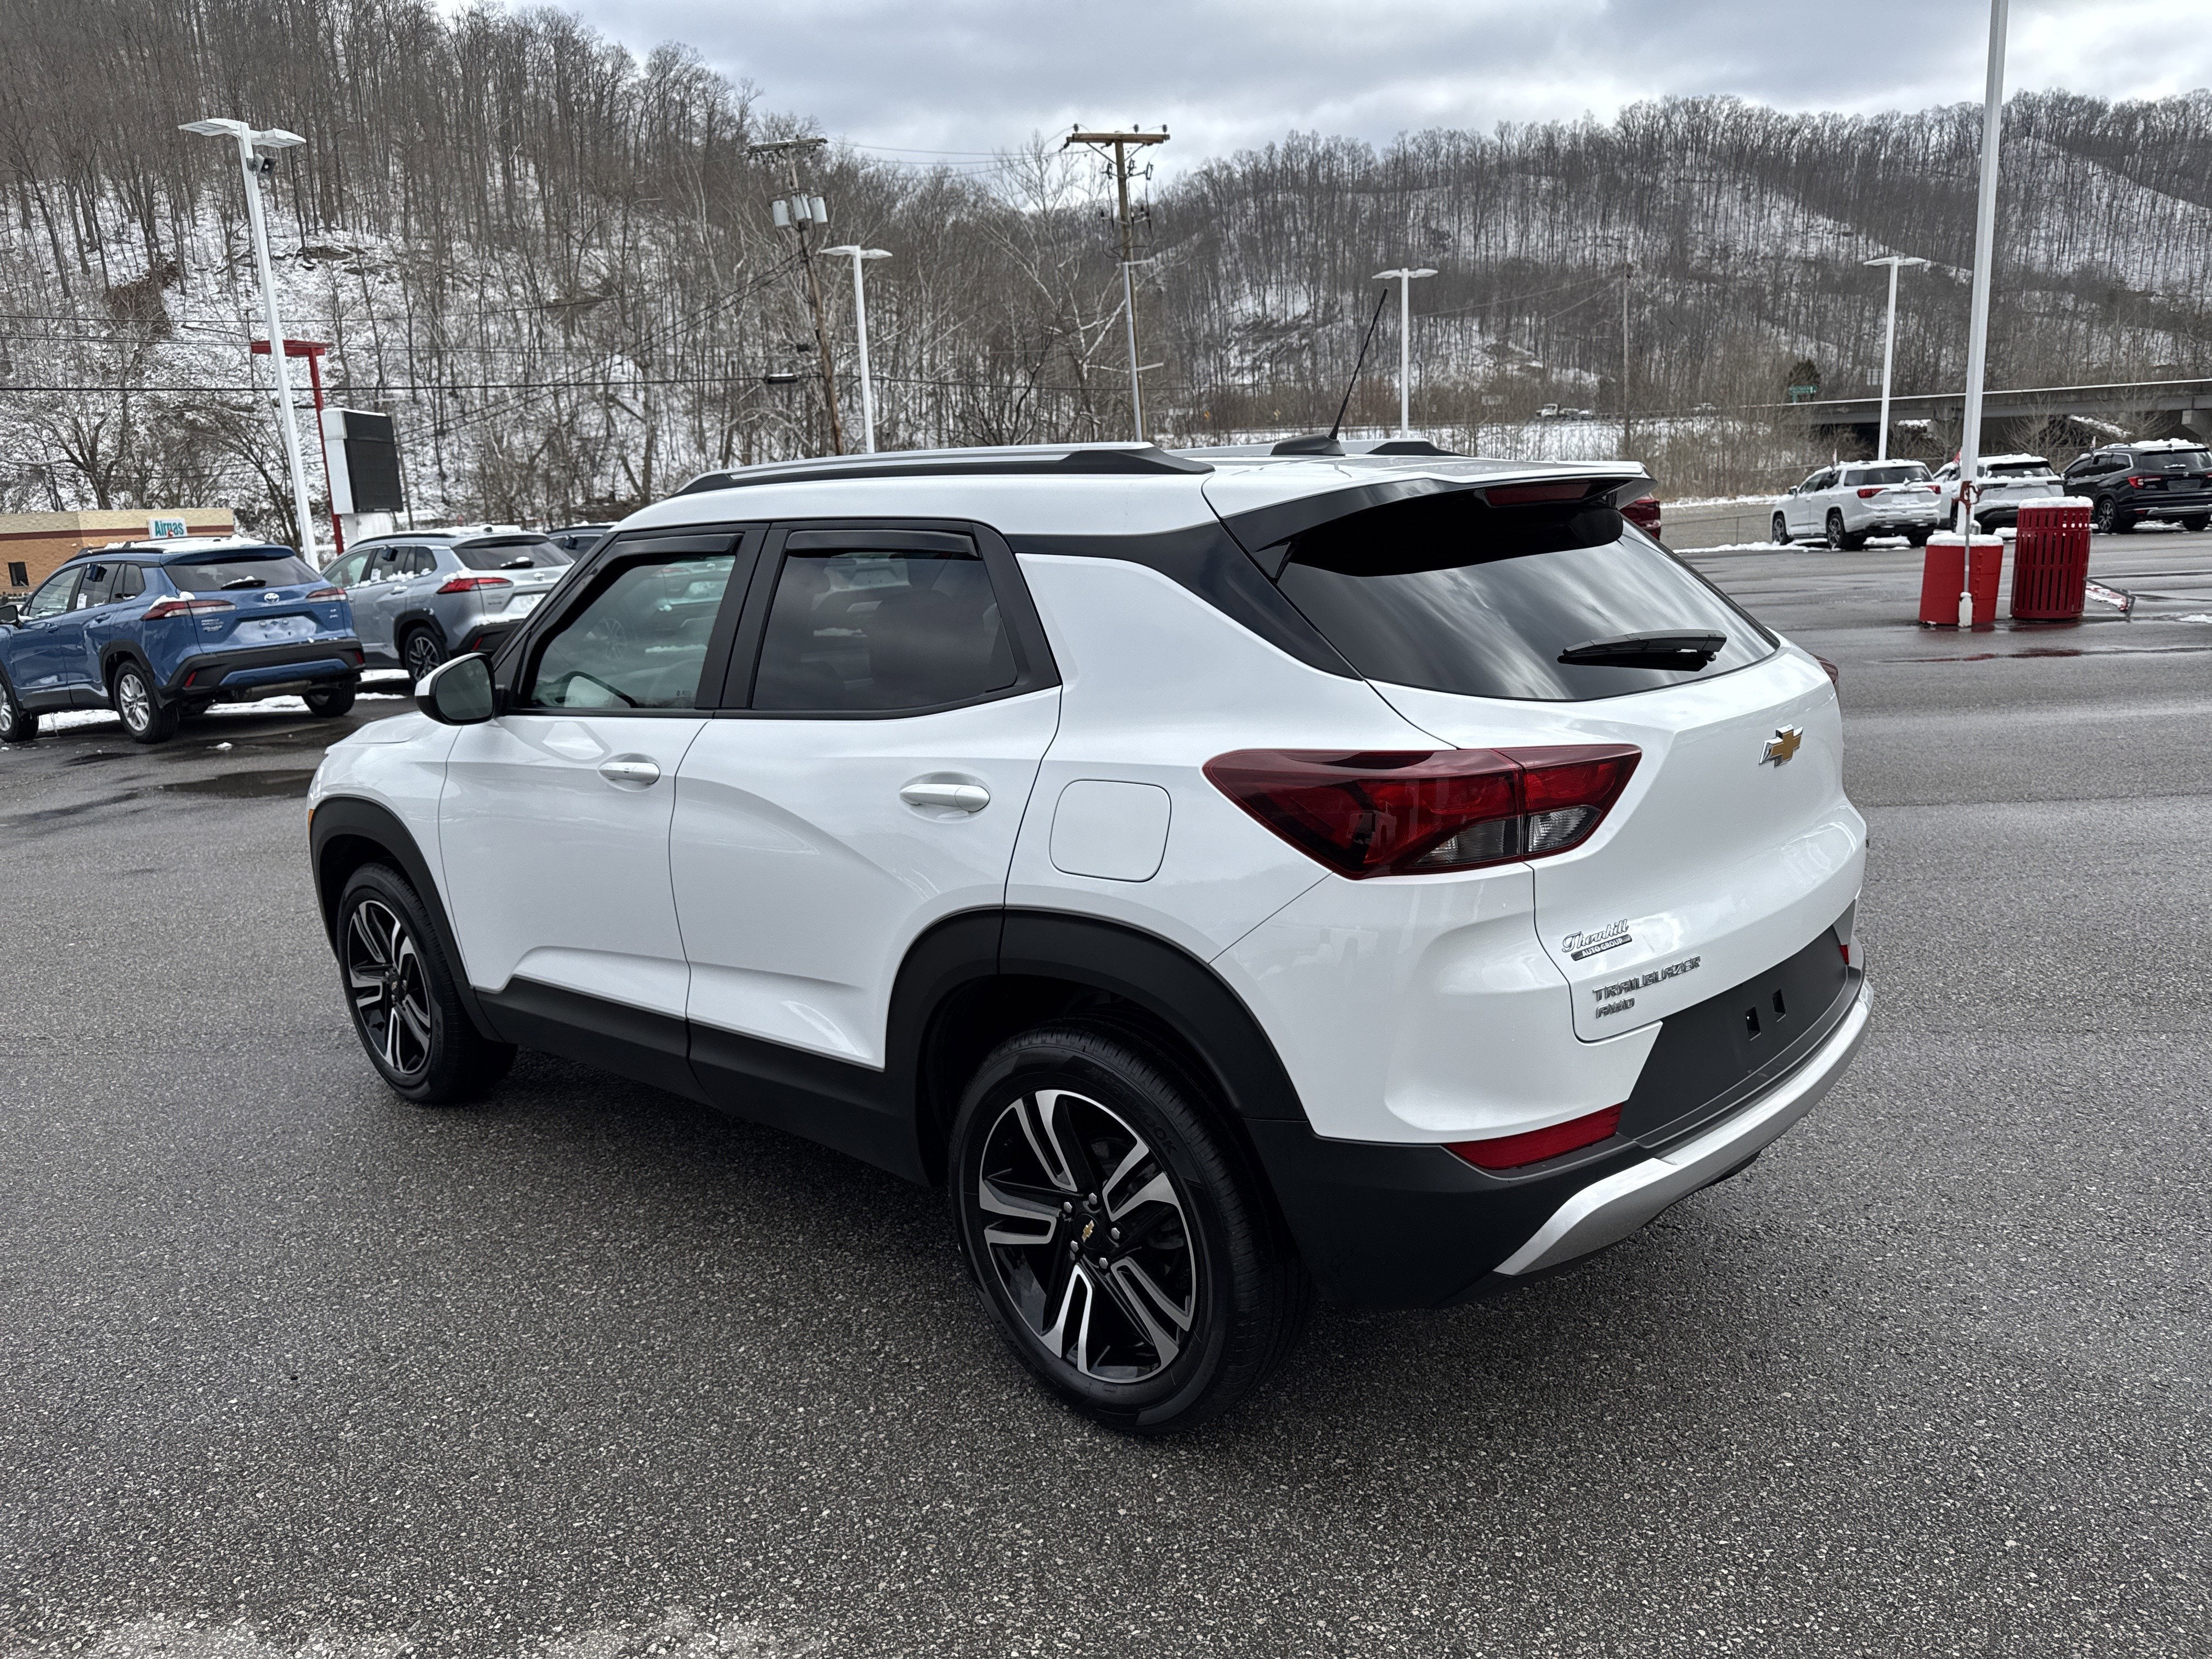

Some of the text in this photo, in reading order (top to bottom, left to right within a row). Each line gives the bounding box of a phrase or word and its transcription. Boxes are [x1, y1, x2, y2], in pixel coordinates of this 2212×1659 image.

[1561, 918, 1629, 952] Thornhill
[1581, 938, 1623, 957] AUTO GROUP
[1593, 956, 1701, 1001] TRAILBLAZER
[1596, 997, 1635, 1018] AWD
